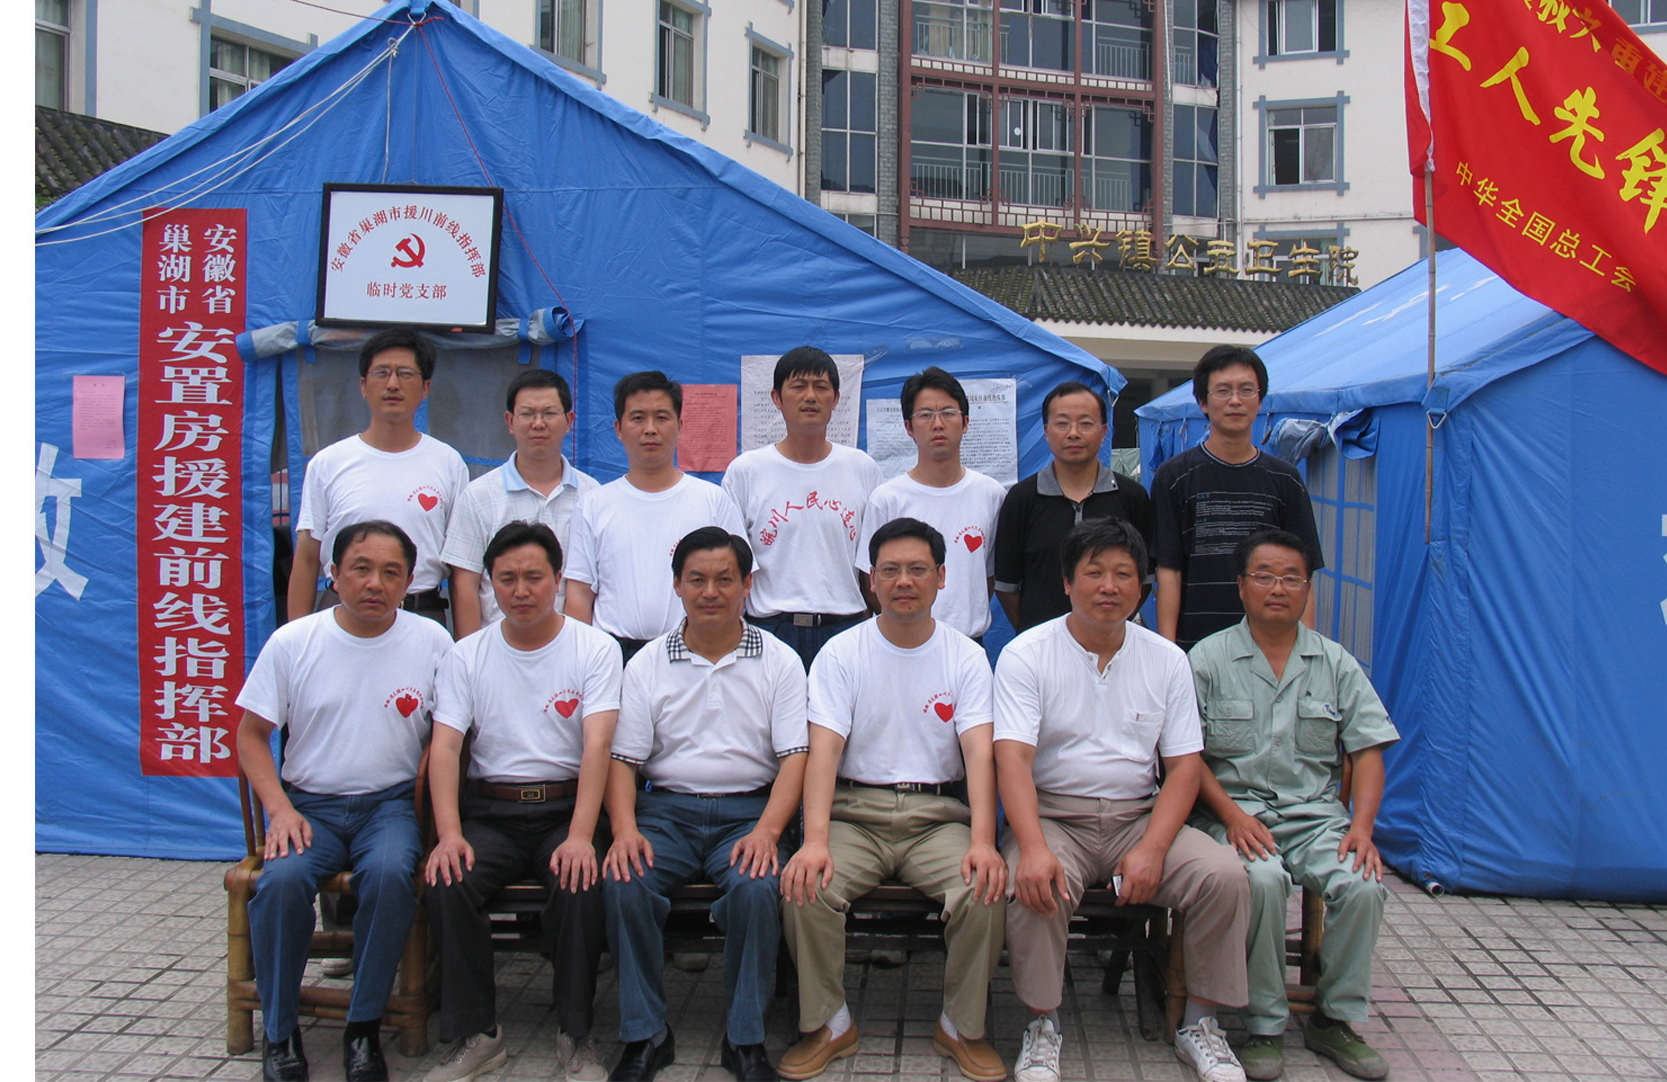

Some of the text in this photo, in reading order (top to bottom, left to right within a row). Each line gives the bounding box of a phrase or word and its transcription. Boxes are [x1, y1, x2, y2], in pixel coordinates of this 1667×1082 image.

[157, 223, 193, 315] 巢湖市
[201, 223, 238, 315] 安徽省
[331, 204, 486, 278] 安徽省巢湖市援川前线指挥部
[1019, 219, 1360, 287] 中兴镇公立卫生院
[1455, 160, 1636, 293] 中华全国总工会
[366, 281, 448, 300] 临时党支部
[151, 320, 236, 765] 安置房援建前线指挥部
